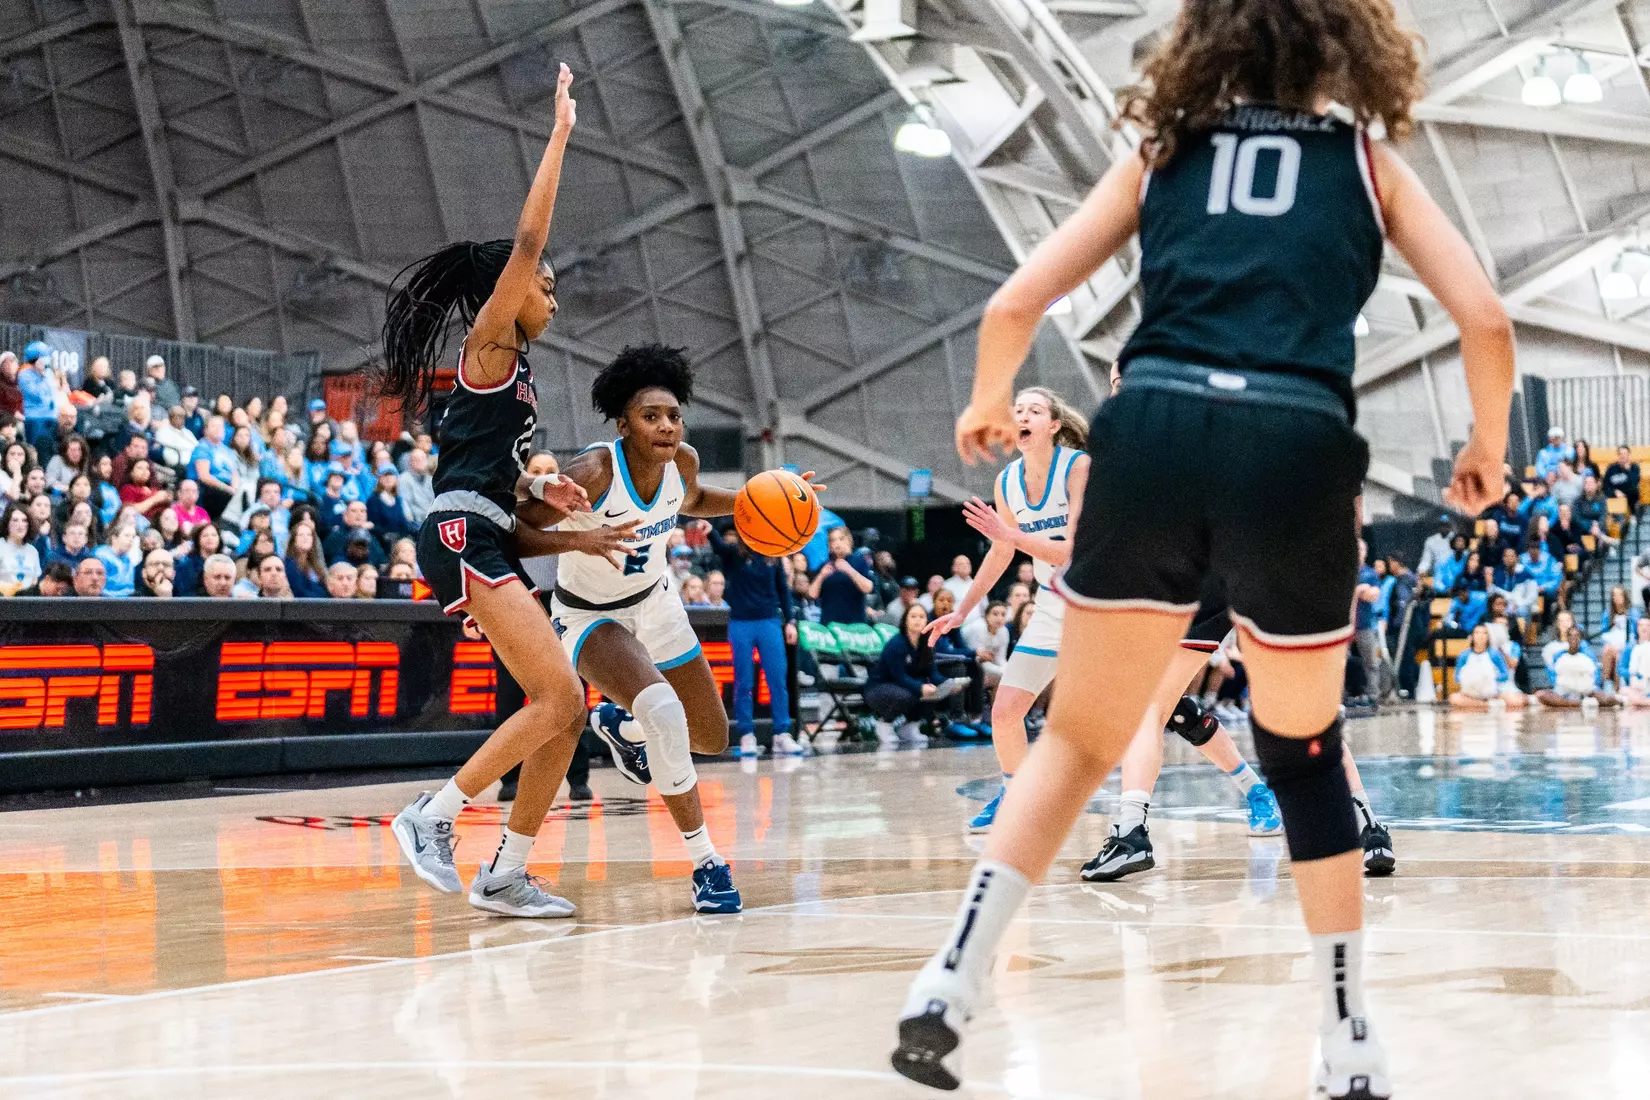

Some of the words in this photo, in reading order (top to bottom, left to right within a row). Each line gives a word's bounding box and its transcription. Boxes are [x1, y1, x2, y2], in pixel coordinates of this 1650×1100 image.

[1206, 132, 1301, 216] 10
[52, 349, 79, 374] 108
[445, 523, 462, 544] H
[0, 644, 155, 730] SPN
[216, 641, 400, 720] ESPN
